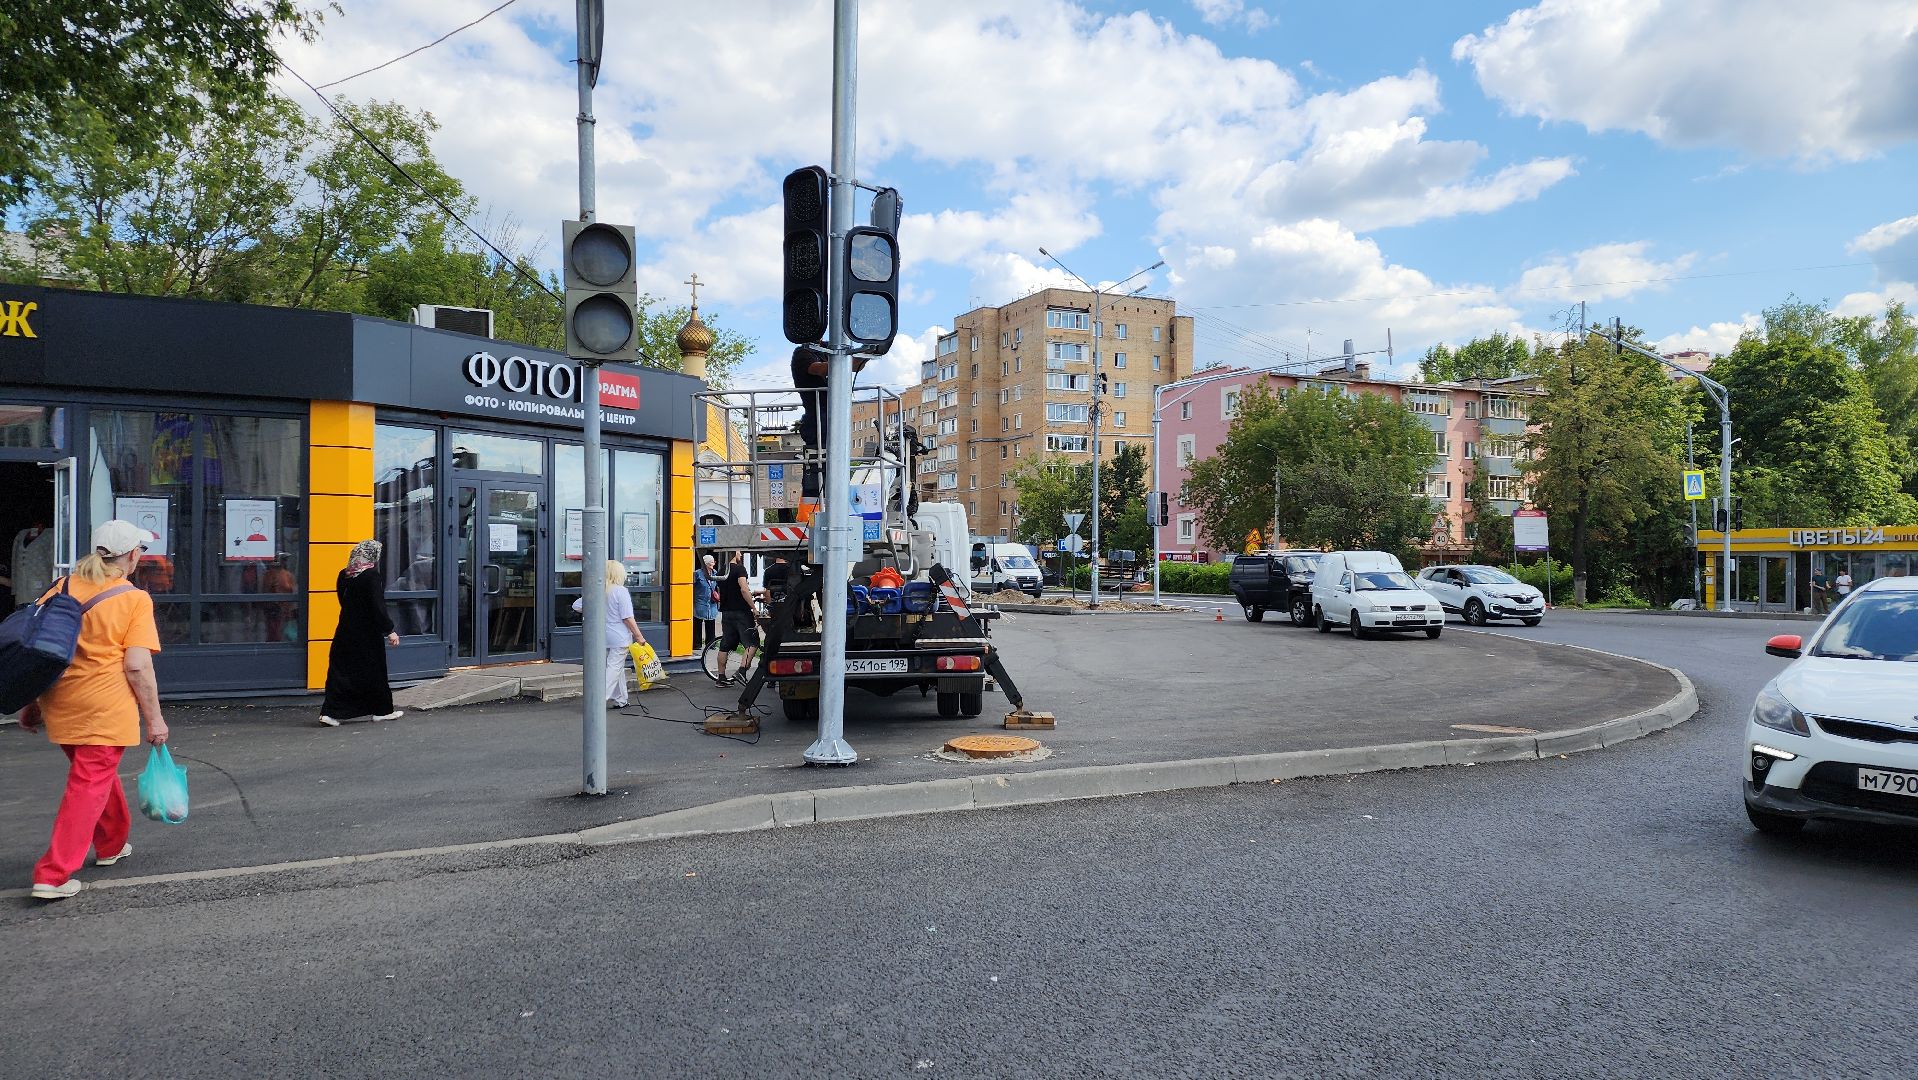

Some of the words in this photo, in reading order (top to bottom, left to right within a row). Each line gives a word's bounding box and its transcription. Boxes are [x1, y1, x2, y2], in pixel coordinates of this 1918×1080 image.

[468, 351, 584, 403] ФОТО
[464, 394, 499, 409] ФОТО
[607, 413, 636, 425] ЦЕНТР
